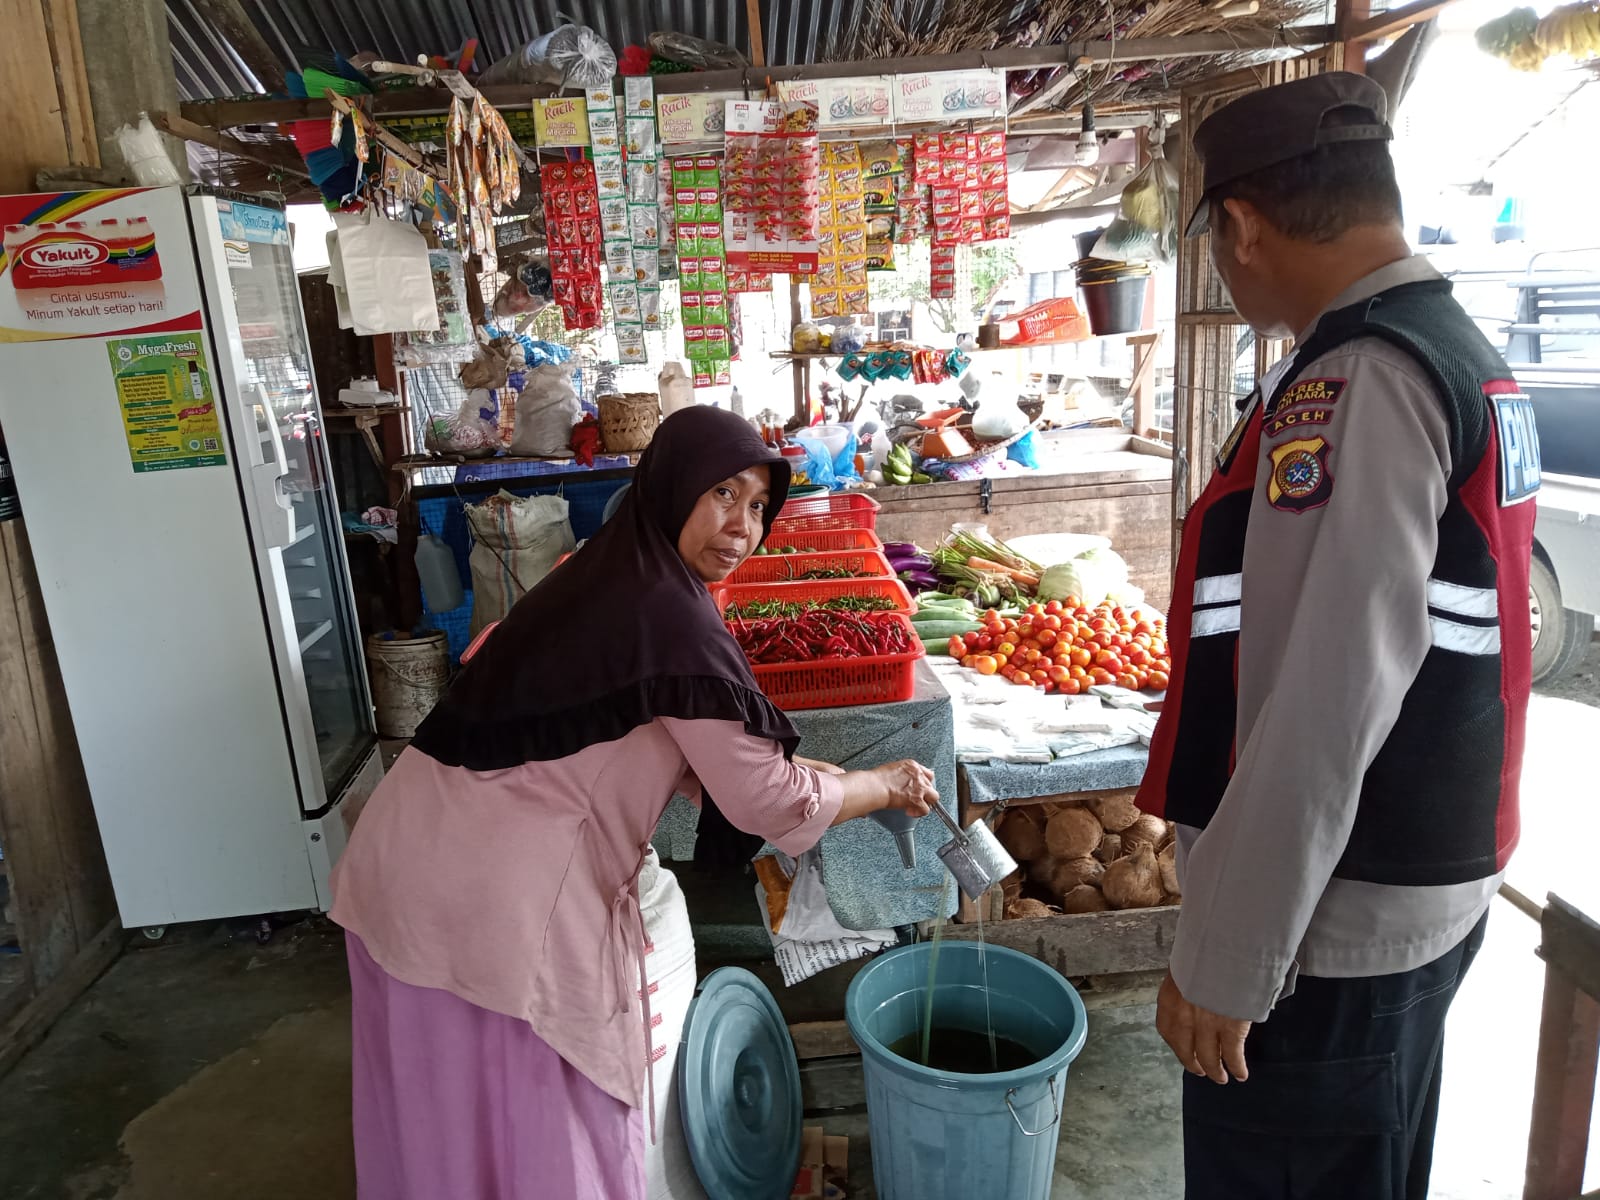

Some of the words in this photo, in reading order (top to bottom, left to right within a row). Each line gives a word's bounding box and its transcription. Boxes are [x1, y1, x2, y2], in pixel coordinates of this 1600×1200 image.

[902, 75, 932, 96] Racik
[544, 100, 575, 121] Racik
[661, 96, 692, 117] Racik
[37, 248, 94, 262] Yakult
[50, 293, 82, 304] Cintai
[85, 291, 135, 301] ususmu..
[26, 310, 64, 321] Minum
[66, 305, 101, 317] Yakult
[103, 303, 136, 315] setiap
[138, 300, 163, 312] hari!
[137, 340, 196, 356] MygaFresh
[1282, 381, 1326, 401] OLRES
[1295, 390, 1335, 402] BARAT
[1274, 410, 1325, 430] ACEH
